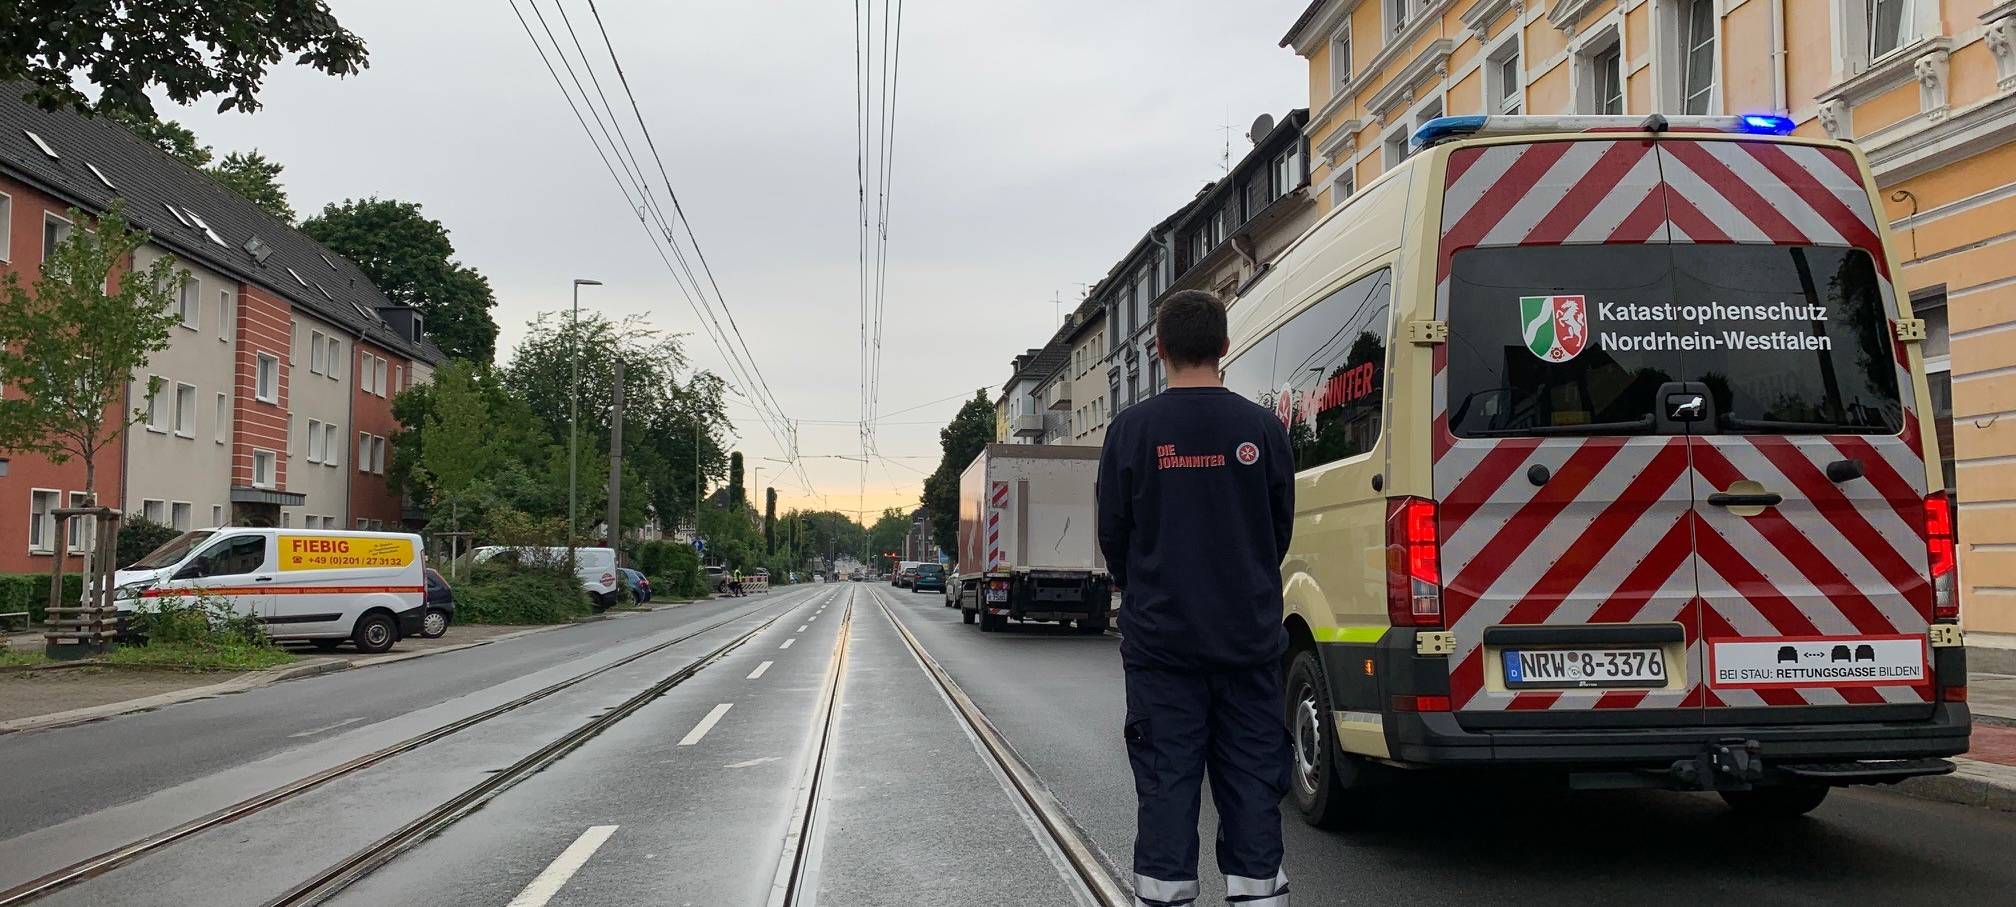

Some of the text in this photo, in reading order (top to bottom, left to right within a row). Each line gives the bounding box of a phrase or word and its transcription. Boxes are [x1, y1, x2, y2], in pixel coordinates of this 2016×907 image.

[1598, 302, 1828, 324] Katastrophenschutz
[1600, 331, 1832, 351] Nordrhein-Westfalen
[1157, 443, 1176, 457] DIE
[1158, 455, 1225, 470] JOHANNITER
[292, 540, 349, 553] FIEBIG
[309, 556, 327, 564] +49
[1520, 652, 1662, 678] NRW 8-3376
[1719, 665, 1920, 680] BEI STAU: RETTUNGSGASSE BILDEN!
